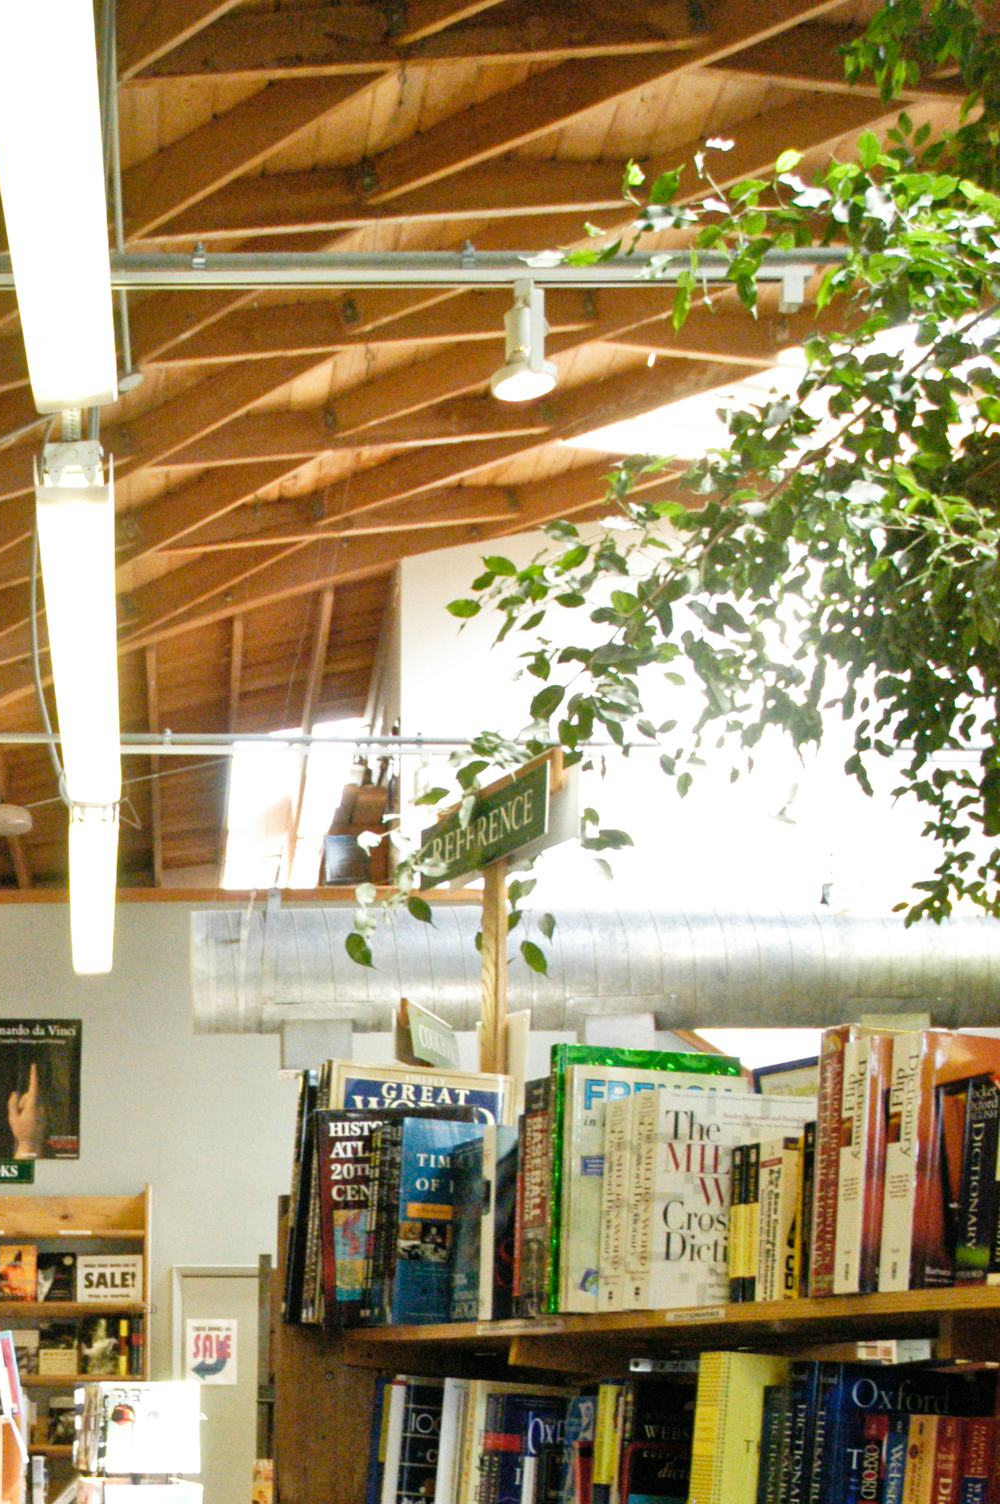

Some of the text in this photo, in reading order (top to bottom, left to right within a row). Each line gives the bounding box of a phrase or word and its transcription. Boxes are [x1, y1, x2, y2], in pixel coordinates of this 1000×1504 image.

[32, 1025, 45, 1036] da
[47, 1025, 77, 1036] Vinci
[381, 1083, 471, 1105] GREAT
[852, 1060, 868, 1160] Dictionary
[899, 1054, 920, 1158] Dictionary
[666, 1110, 721, 1141] The
[640, 1148, 654, 1216] MILLION
[966, 1119, 986, 1251] DICTIONARY
[638, 1217, 650, 1269] WORD
[84, 1272, 136, 1289] SALE!
[193, 1334, 231, 1360] SALE
[851, 1377, 950, 1415] Oxford
[861, 1444, 880, 1500] OXFORD
